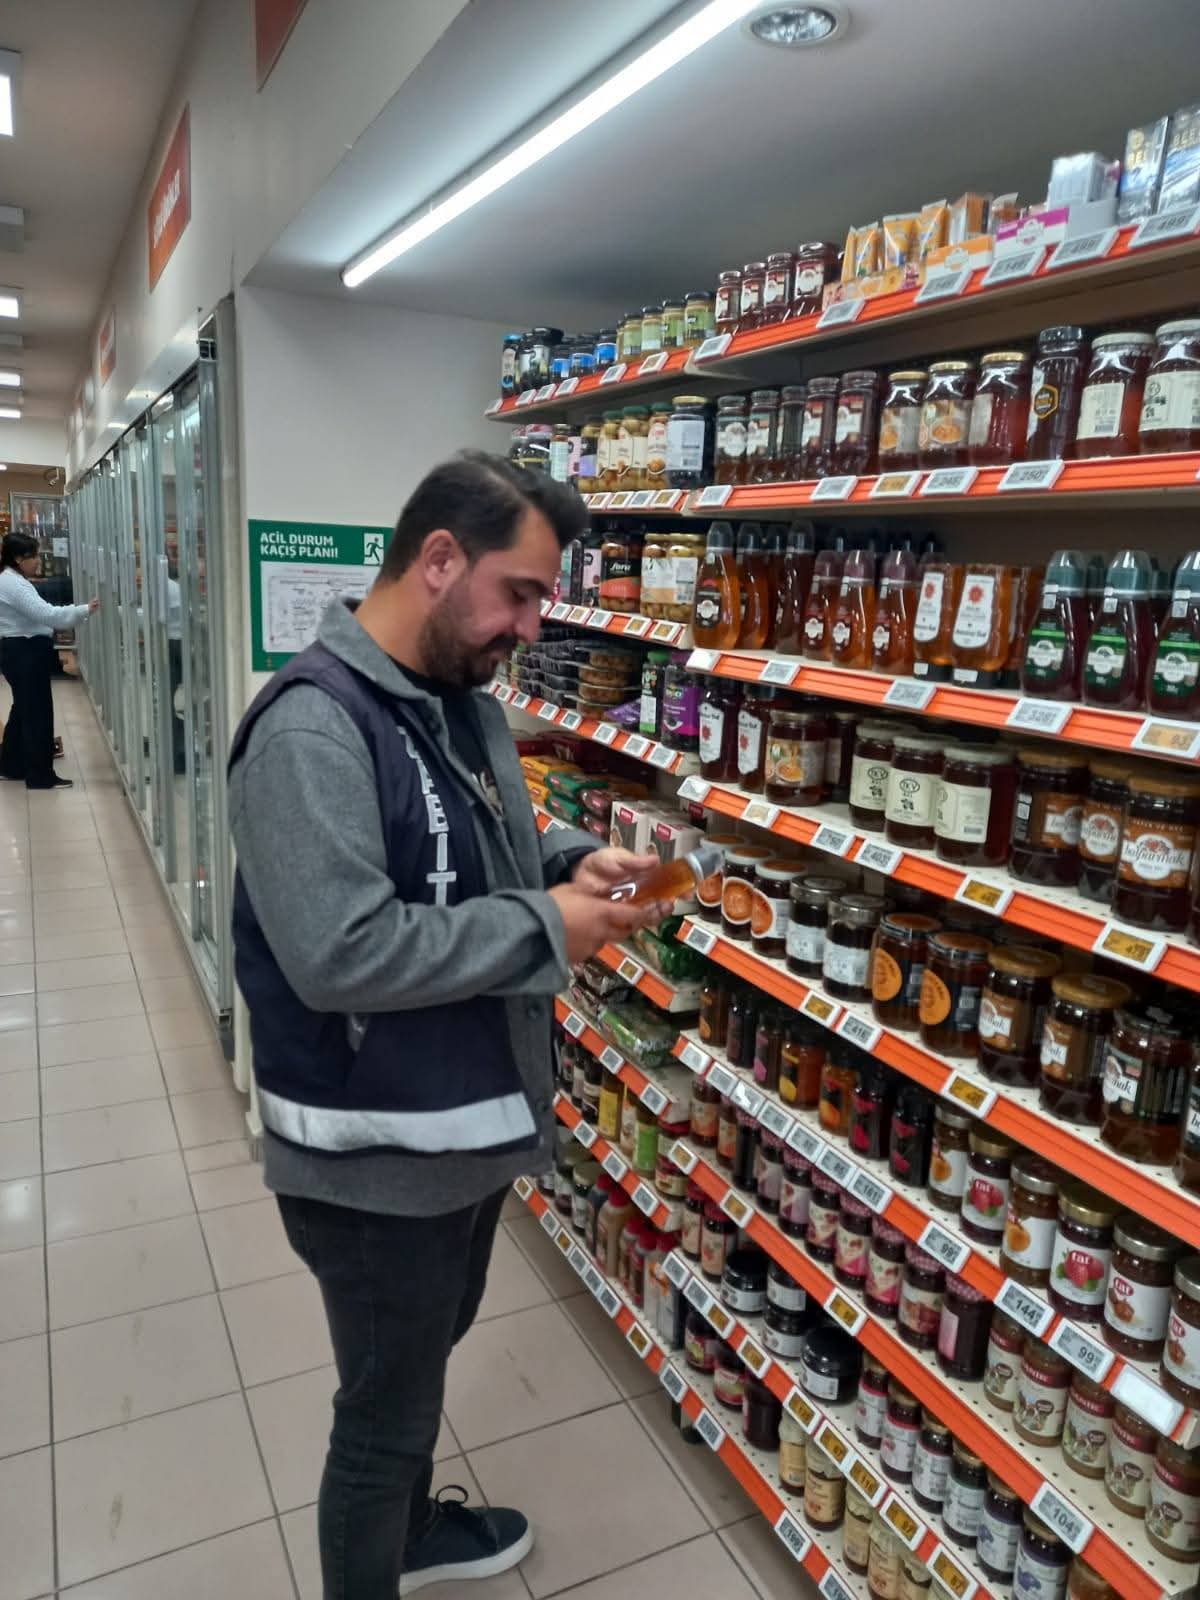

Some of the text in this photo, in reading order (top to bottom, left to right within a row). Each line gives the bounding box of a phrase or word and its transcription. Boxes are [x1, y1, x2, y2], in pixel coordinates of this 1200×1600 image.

[260, 531, 334, 547] ACİL DURUM
[260, 544, 297, 559] KAÇIŞ
[1015, 1299, 1037, 1321] 144
[1052, 1507, 1075, 1533] 104
